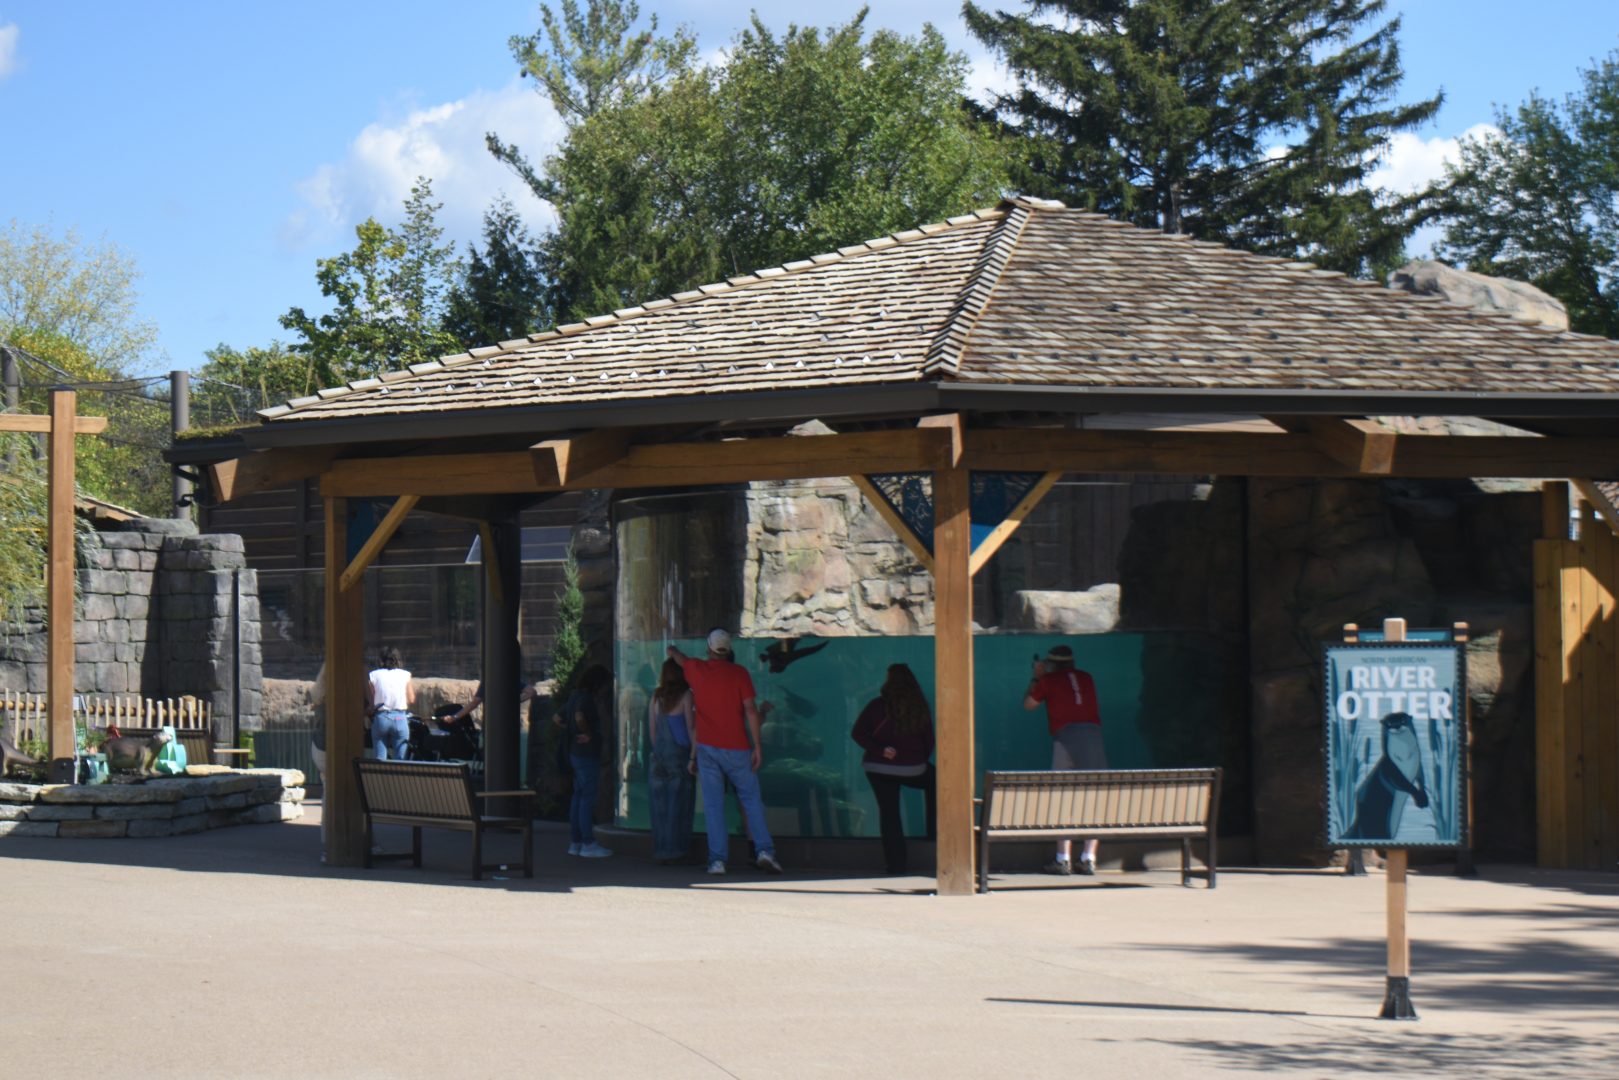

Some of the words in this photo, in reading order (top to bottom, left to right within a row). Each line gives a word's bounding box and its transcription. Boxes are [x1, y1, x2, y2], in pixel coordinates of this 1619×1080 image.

[1361, 656, 1385, 664] NORTH
[1388, 656, 1427, 664] AMERICAN
[1351, 666, 1436, 689] RIVER
[1337, 690, 1453, 720] OTTER
